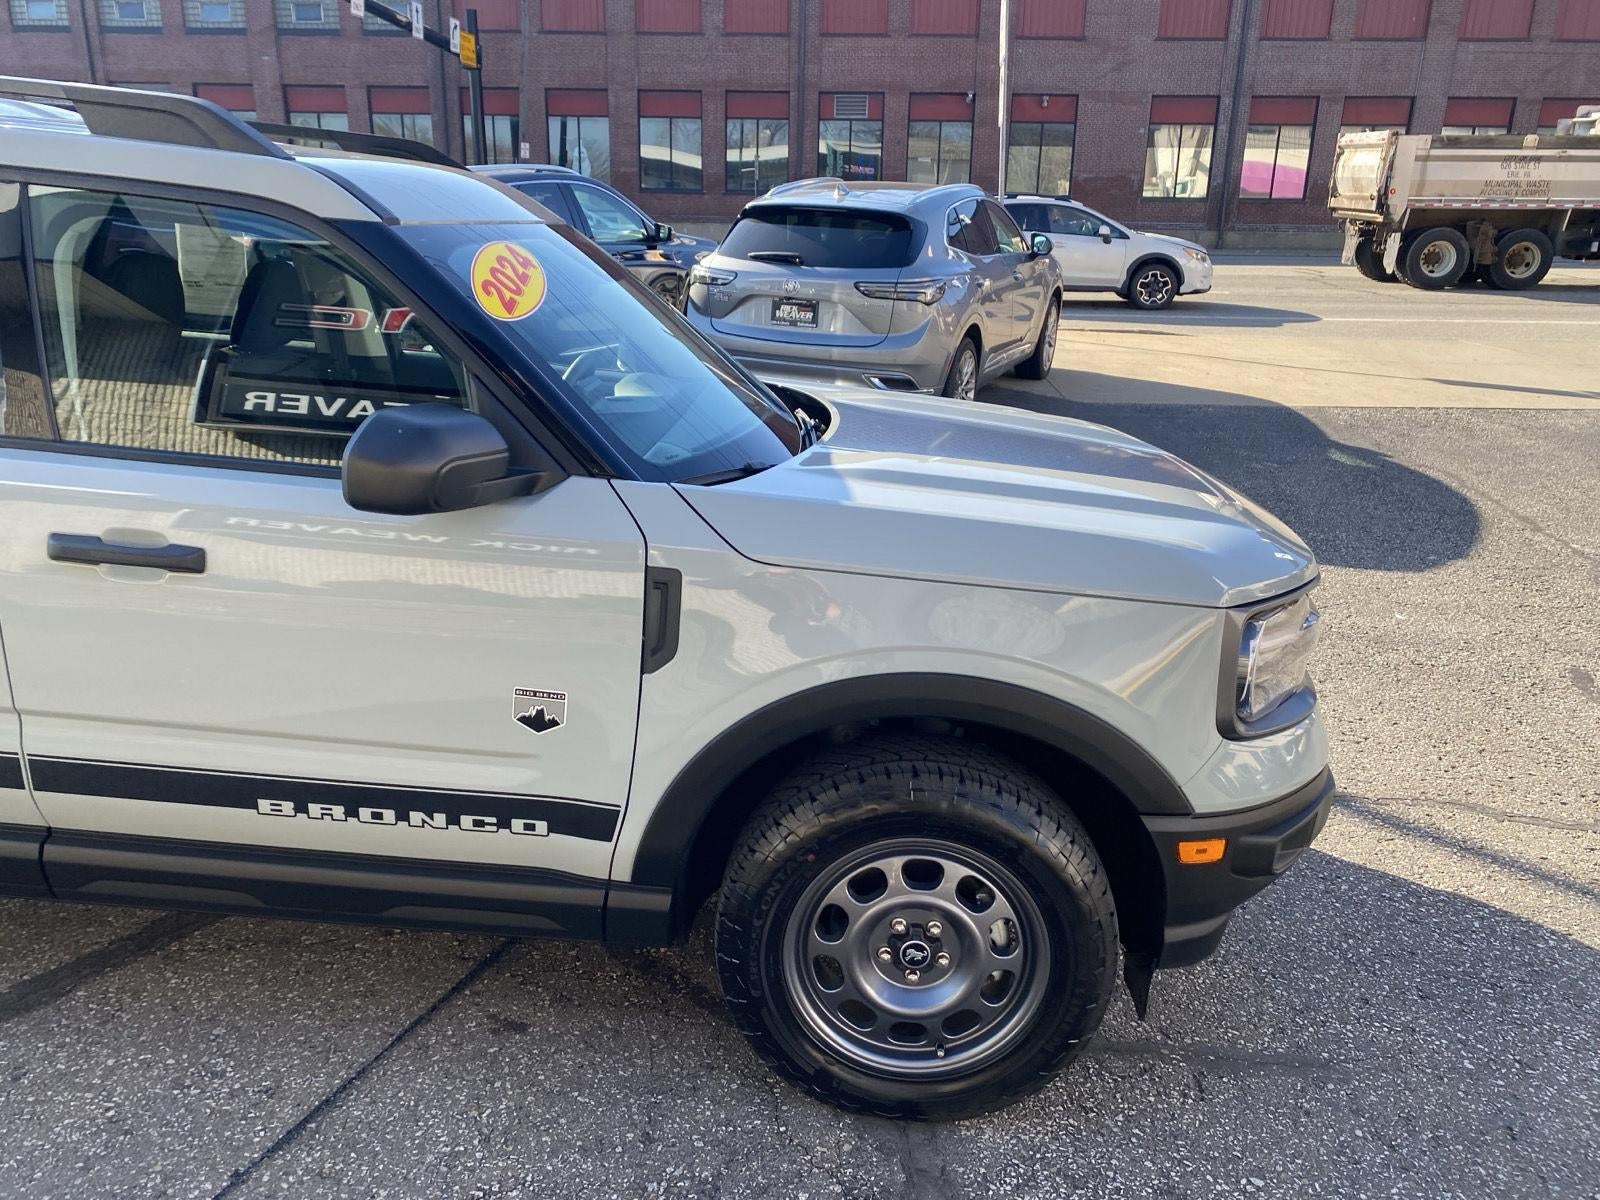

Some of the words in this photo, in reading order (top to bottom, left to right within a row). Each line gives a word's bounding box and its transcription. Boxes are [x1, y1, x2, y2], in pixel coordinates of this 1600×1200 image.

[1514, 162, 1530, 170] STATE
[1533, 162, 1541, 170] ST
[1484, 180, 1523, 188] MUNICIPAL
[1526, 180, 1551, 188] WASTE
[1521, 188, 1551, 197] COMPOST
[481, 244, 537, 315] 2024
[775, 309, 814, 319] WEAVER
[515, 689, 534, 697] BIG
[536, 692, 565, 700] BEND
[257, 798, 549, 836] BRONCO
